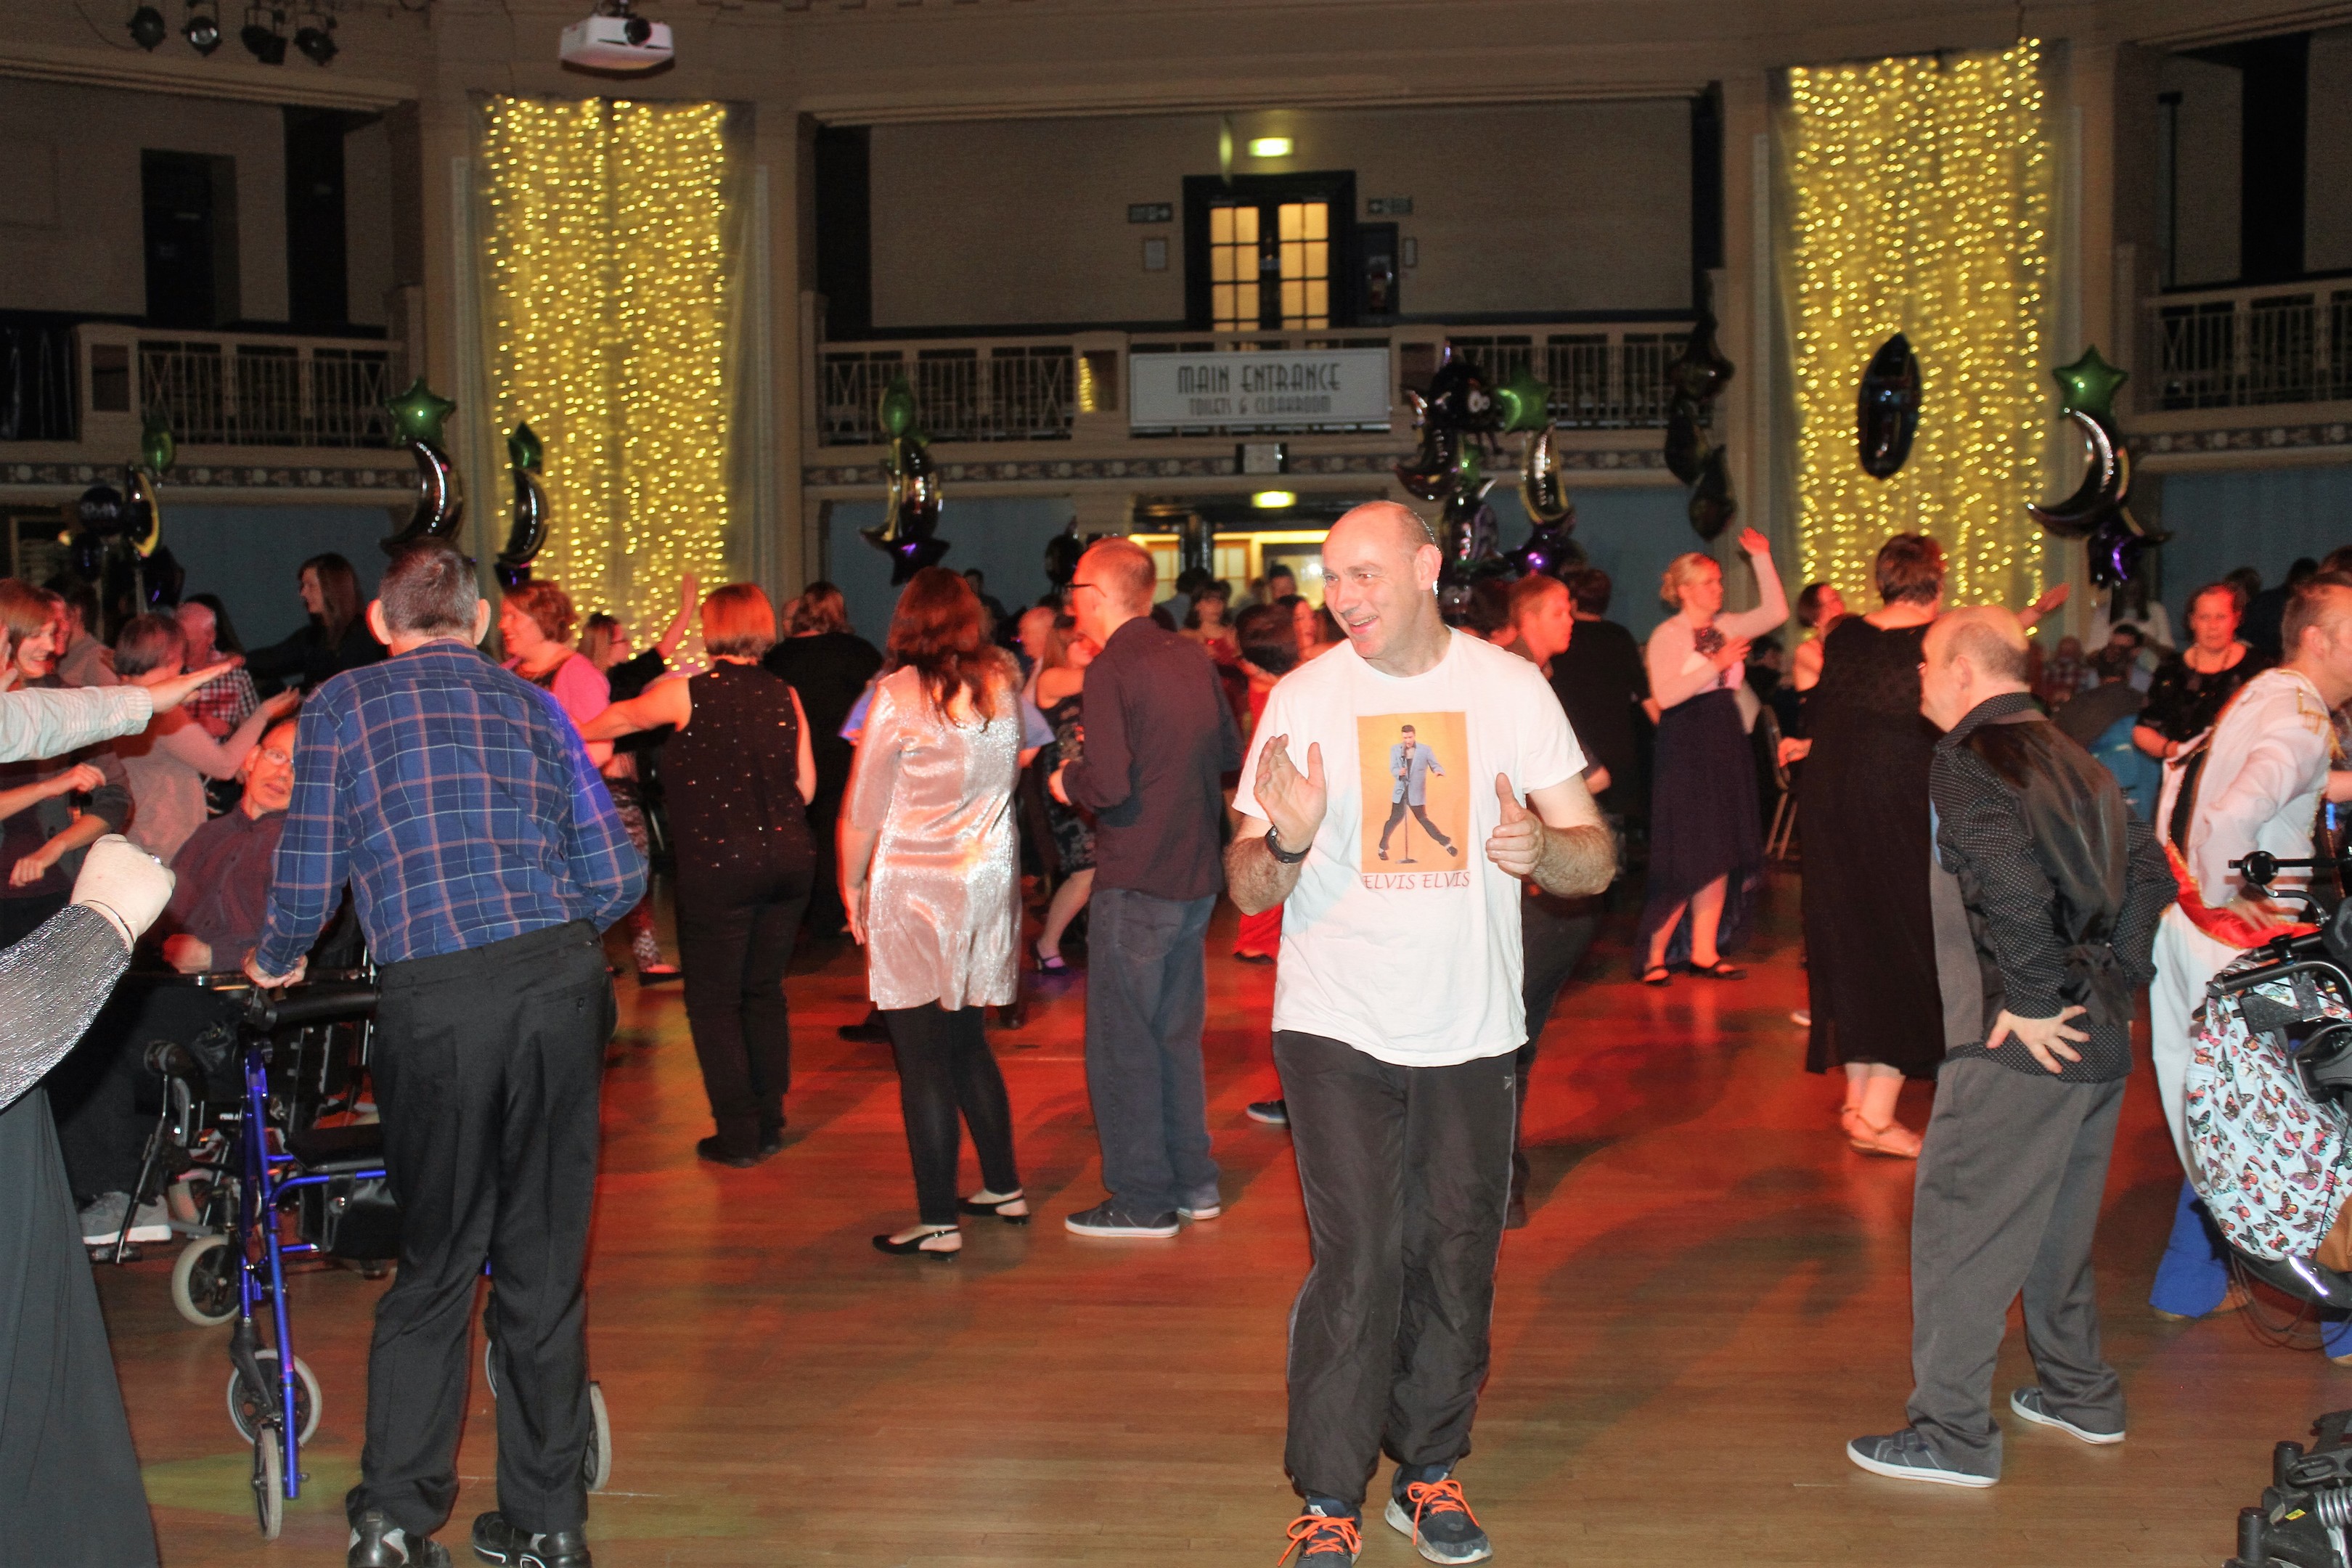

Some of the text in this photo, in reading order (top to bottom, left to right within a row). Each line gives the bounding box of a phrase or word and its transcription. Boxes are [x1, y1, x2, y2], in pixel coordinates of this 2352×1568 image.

[1177, 363, 1341, 393] MAIN ENTRANCE
[1363, 871, 1470, 890] ELVIS ELVIS
